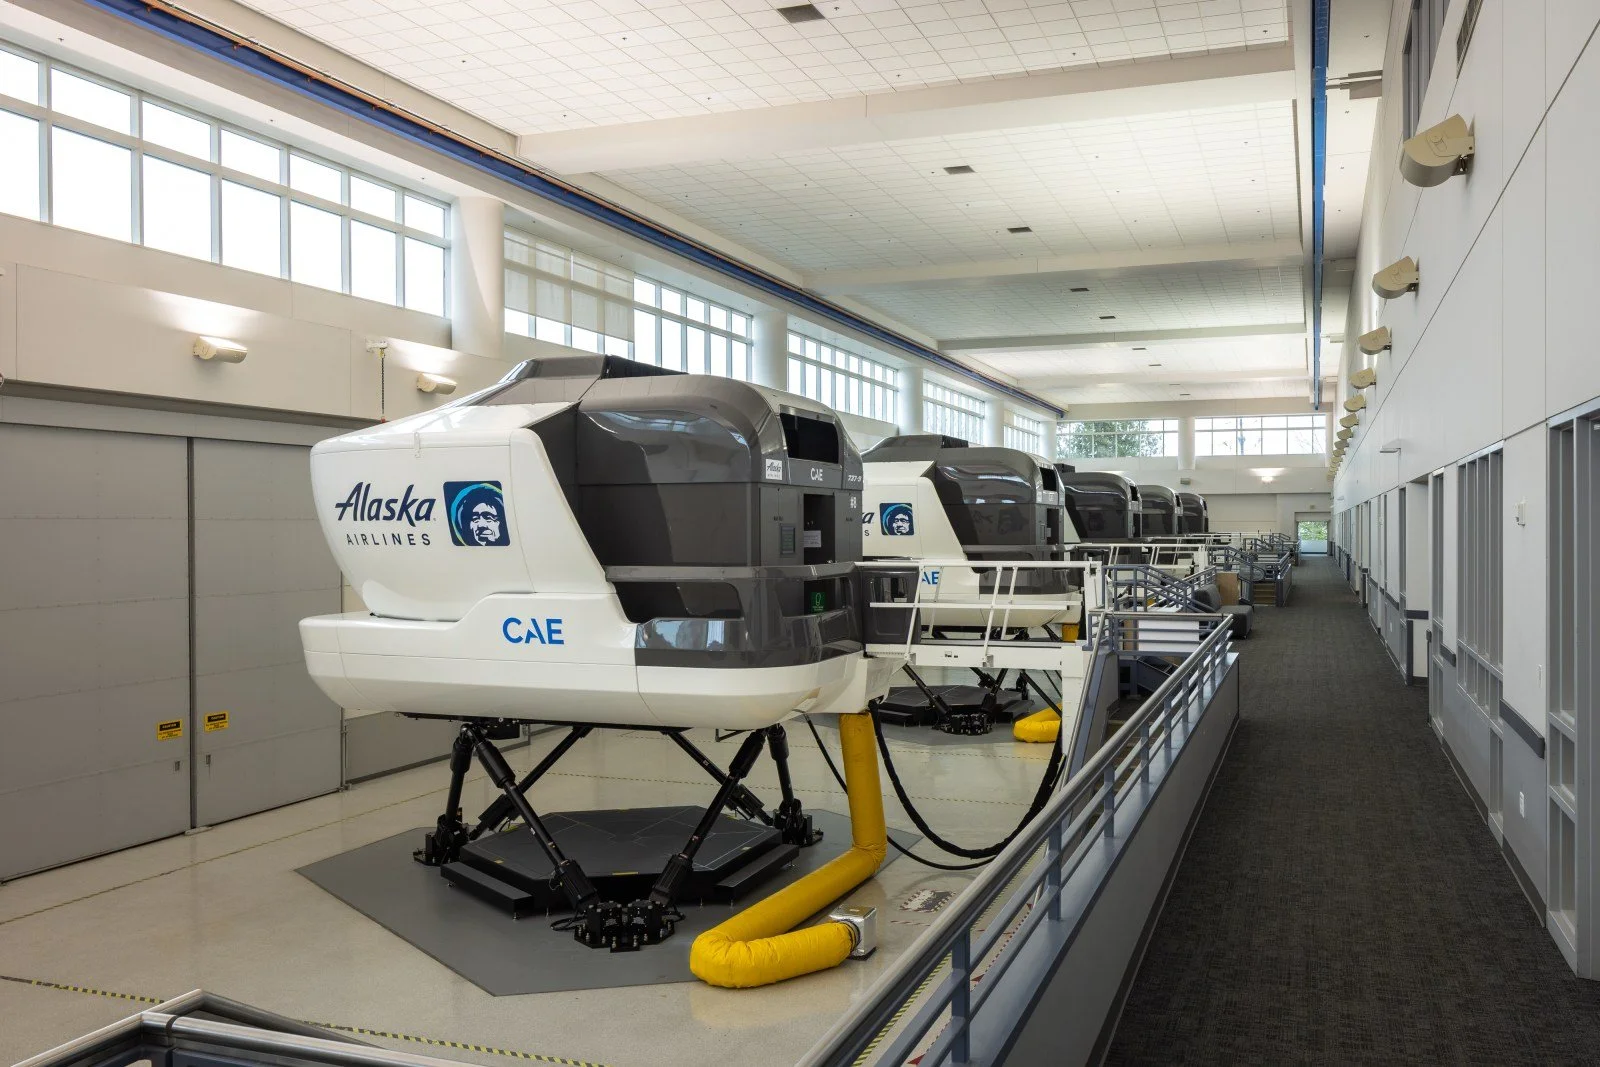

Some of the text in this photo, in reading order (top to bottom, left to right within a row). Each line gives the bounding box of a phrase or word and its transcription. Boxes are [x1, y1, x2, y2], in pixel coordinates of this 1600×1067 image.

[810, 467, 823, 481] CAE
[334, 481, 437, 527] Alaska
[346, 533, 431, 546] AIRLINES
[922, 571, 939, 585] AE
[502, 617, 564, 645] CAE
